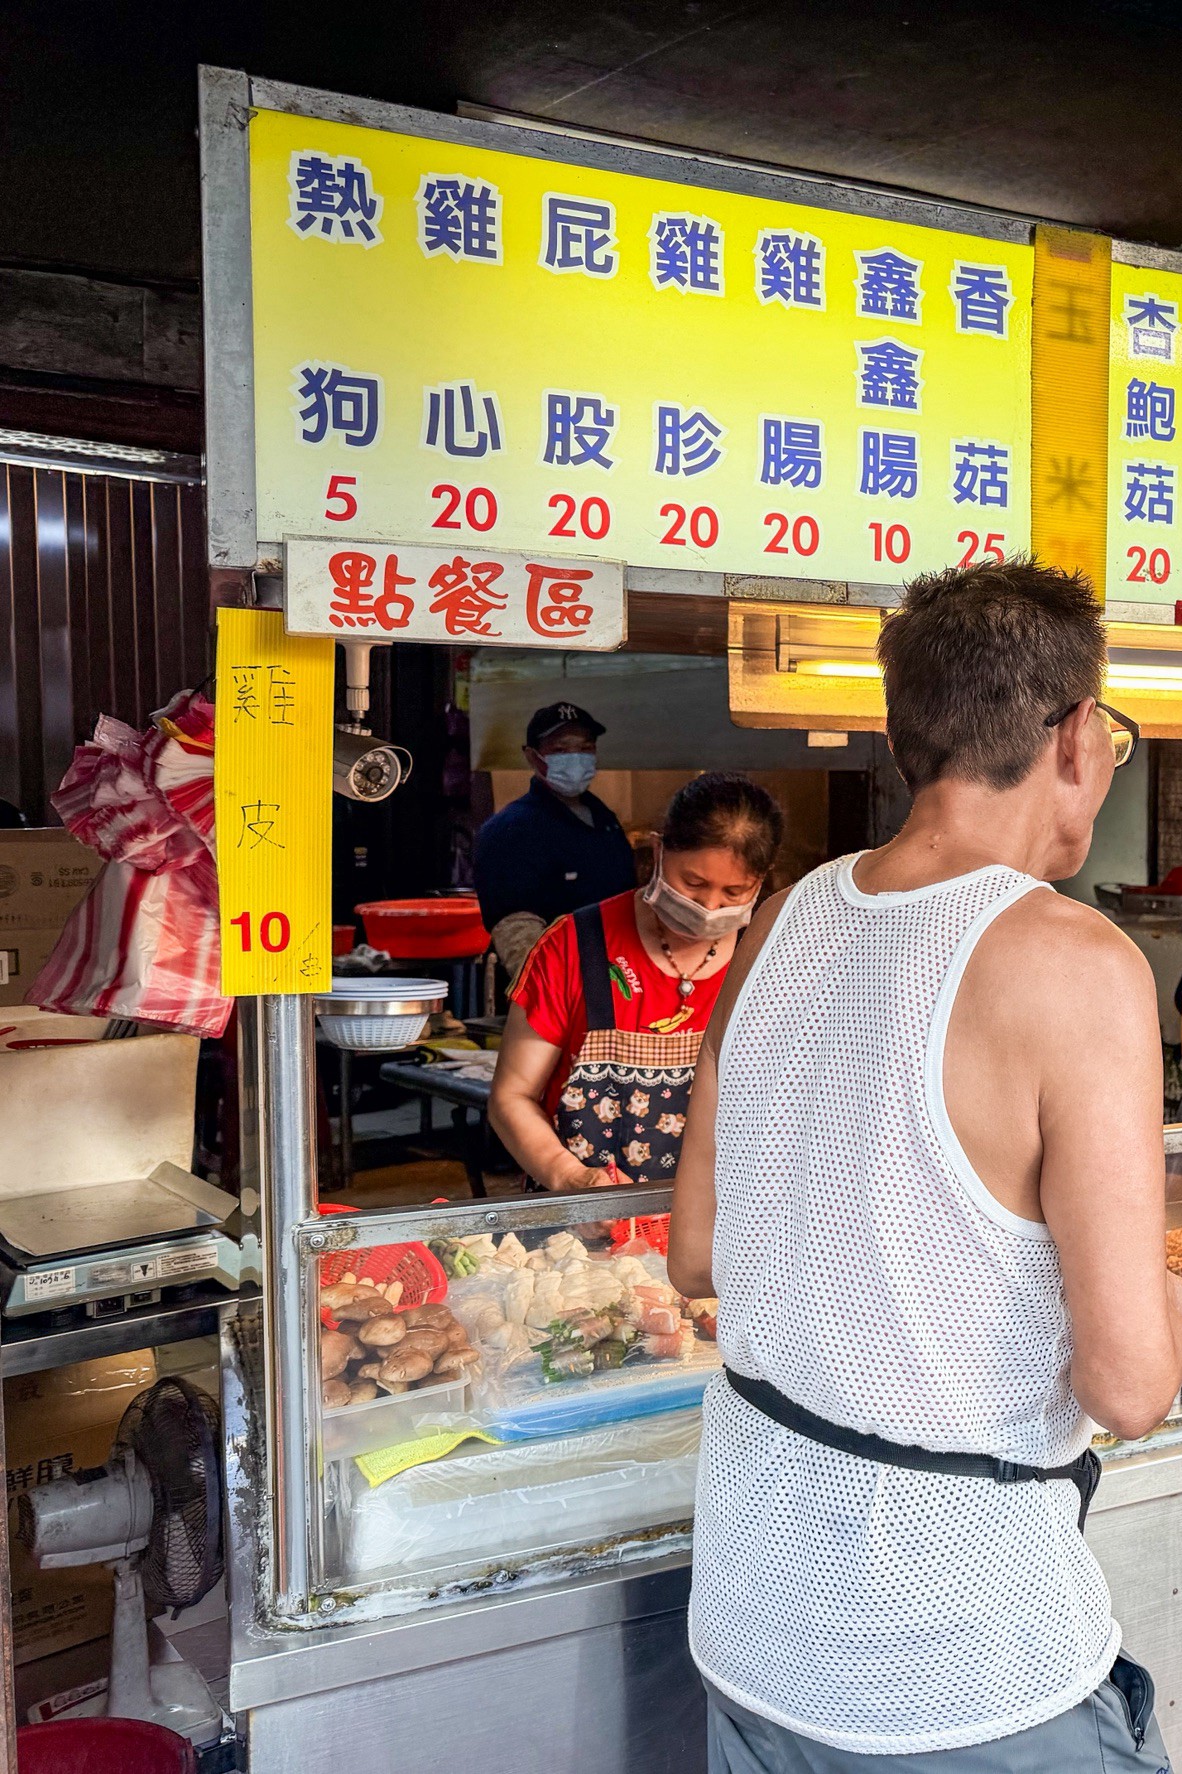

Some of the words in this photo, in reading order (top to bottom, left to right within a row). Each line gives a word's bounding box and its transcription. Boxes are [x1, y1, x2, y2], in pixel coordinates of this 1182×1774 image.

[295, 156, 378, 447] 熱狗
[423, 179, 500, 457] 雞心
[544, 198, 614, 469] 屁股
[655, 218, 721, 476] 雞胗
[760, 234, 822, 489] 雞腸
[859, 251, 919, 499] 鑫鑫腸
[953, 266, 1010, 507] 香菇
[1124, 299, 1176, 524] 杏鮑菇
[325, 475, 357, 522] 5
[431, 484, 498, 532] 20
[548, 493, 611, 540] 20
[660, 503, 719, 549] 20
[763, 512, 819, 557] 20
[868, 522, 911, 564] 10
[957, 530, 1005, 568] 25
[1127, 546, 1171, 584] 20
[328, 551, 593, 638] 點餐區
[231, 664, 296, 850] 雞皮
[230, 911, 291, 953] 10
